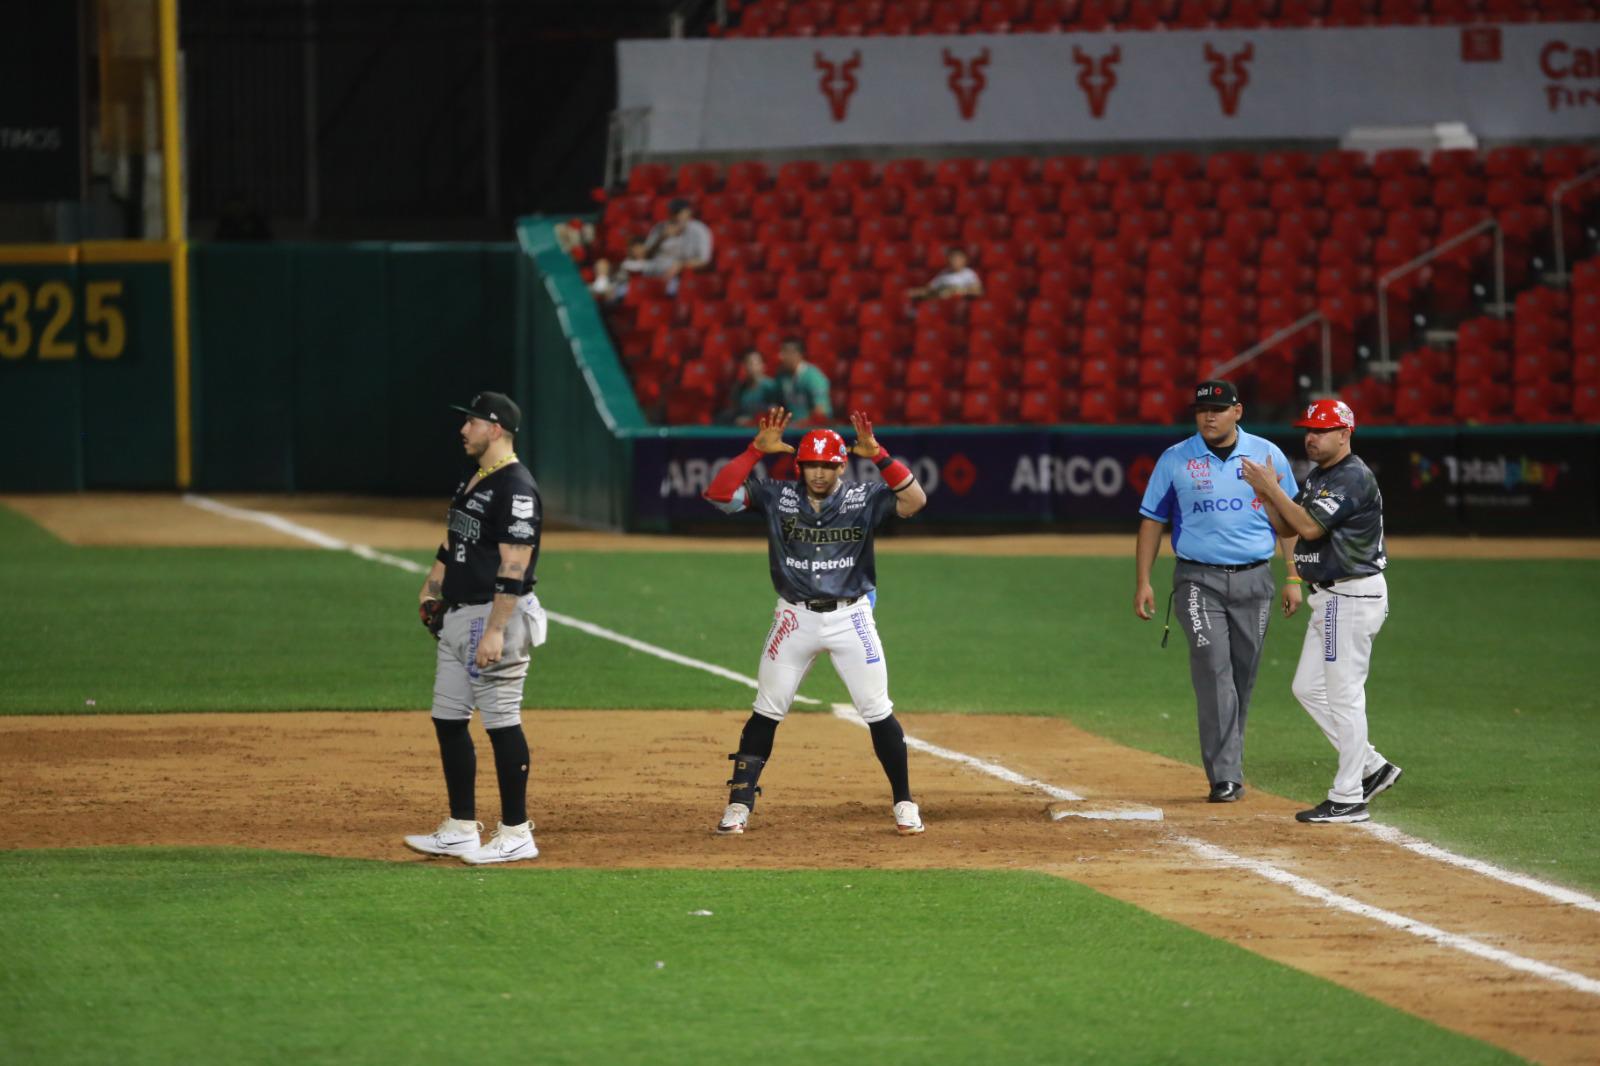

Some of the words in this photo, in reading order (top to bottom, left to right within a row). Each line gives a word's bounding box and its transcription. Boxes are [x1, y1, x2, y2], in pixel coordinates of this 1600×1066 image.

[0, 281, 126, 359] 325
[1010, 454, 1124, 496] ARCO
[1187, 457, 1210, 470] Red
[1193, 498, 1243, 514] ARCO
[455, 543, 466, 563] 2
[786, 557, 808, 569] Red
[1188, 583, 1203, 633] Totalplay
[1325, 600, 1333, 654] PAQUETEXPRESS
